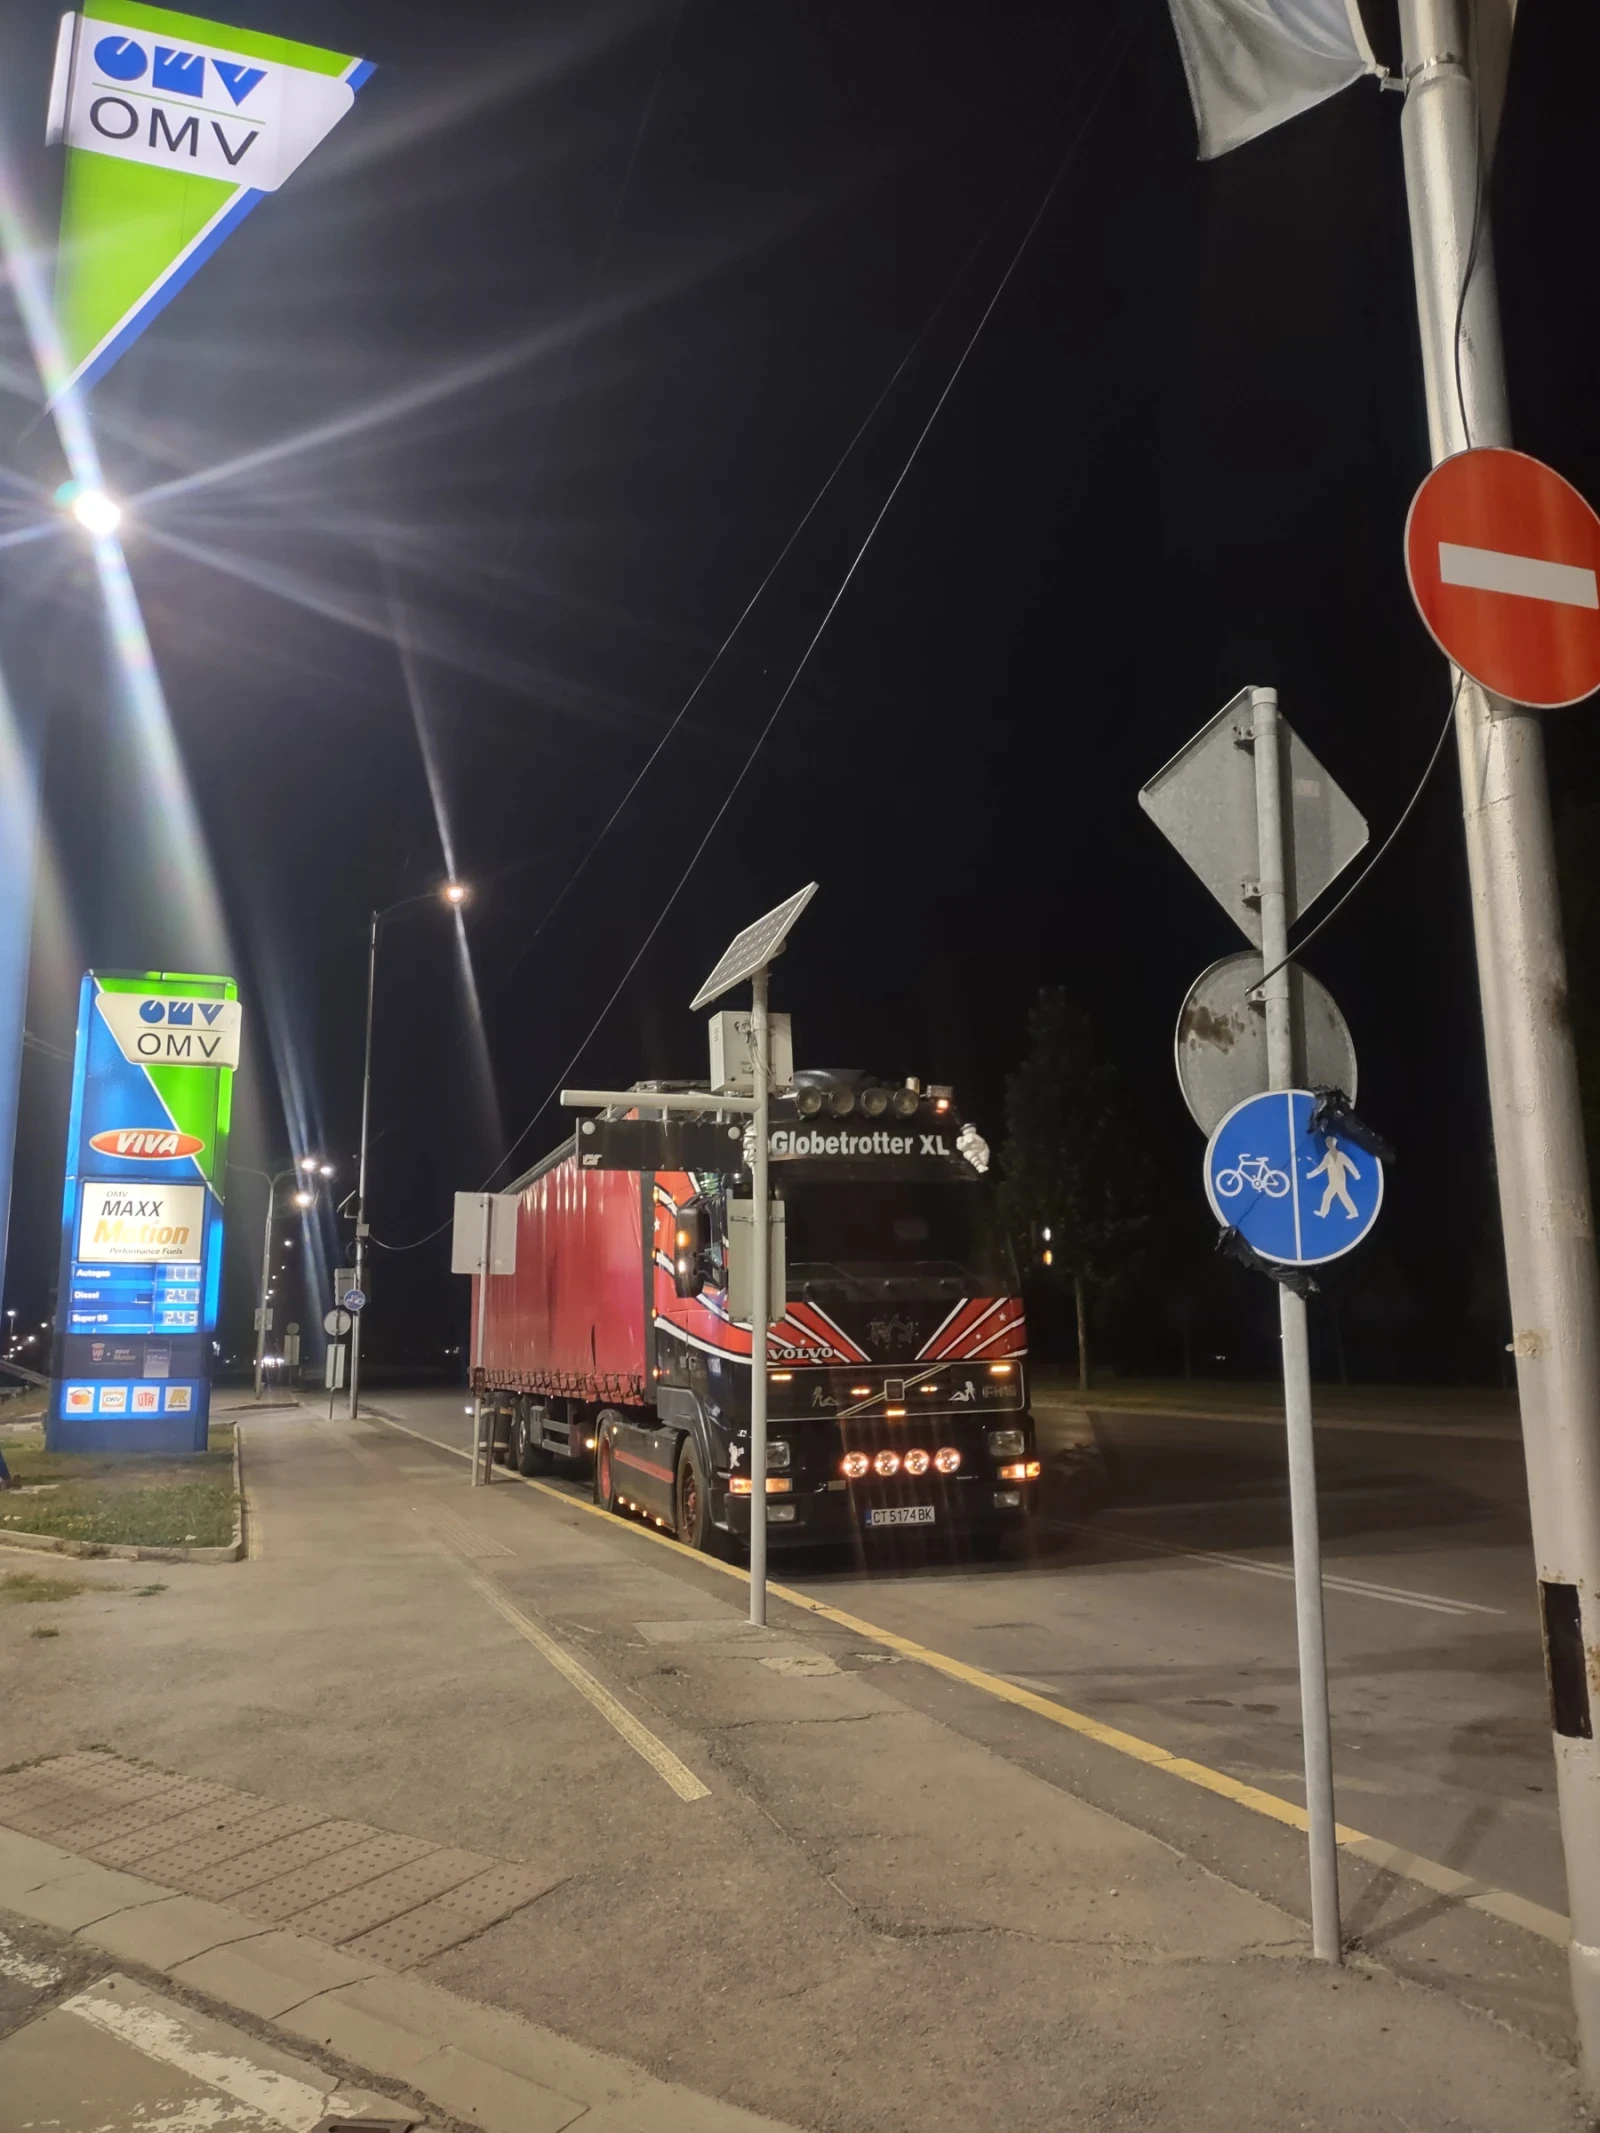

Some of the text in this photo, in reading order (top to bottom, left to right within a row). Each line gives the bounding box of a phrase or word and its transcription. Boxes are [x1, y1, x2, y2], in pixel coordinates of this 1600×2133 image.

[89, 96, 260, 166] OMV
[137, 1032, 222, 1058] OMV
[116, 1132, 180, 1155] VIVA
[771, 1130, 951, 1156] Globetrotter XL
[106, 1190, 129, 1199] OMV
[100, 1200, 164, 1217] MAXX
[93, 1218, 190, 1245] Motion
[109, 1247, 183, 1255] Performance Fuels
[76, 1268, 112, 1279] Autogas
[73, 1290, 100, 1299] Diesel
[72, 1314, 96, 1323] Super
[768, 1347, 834, 1360] VOLVO
[873, 1508, 932, 1523] CT 5174 BK
